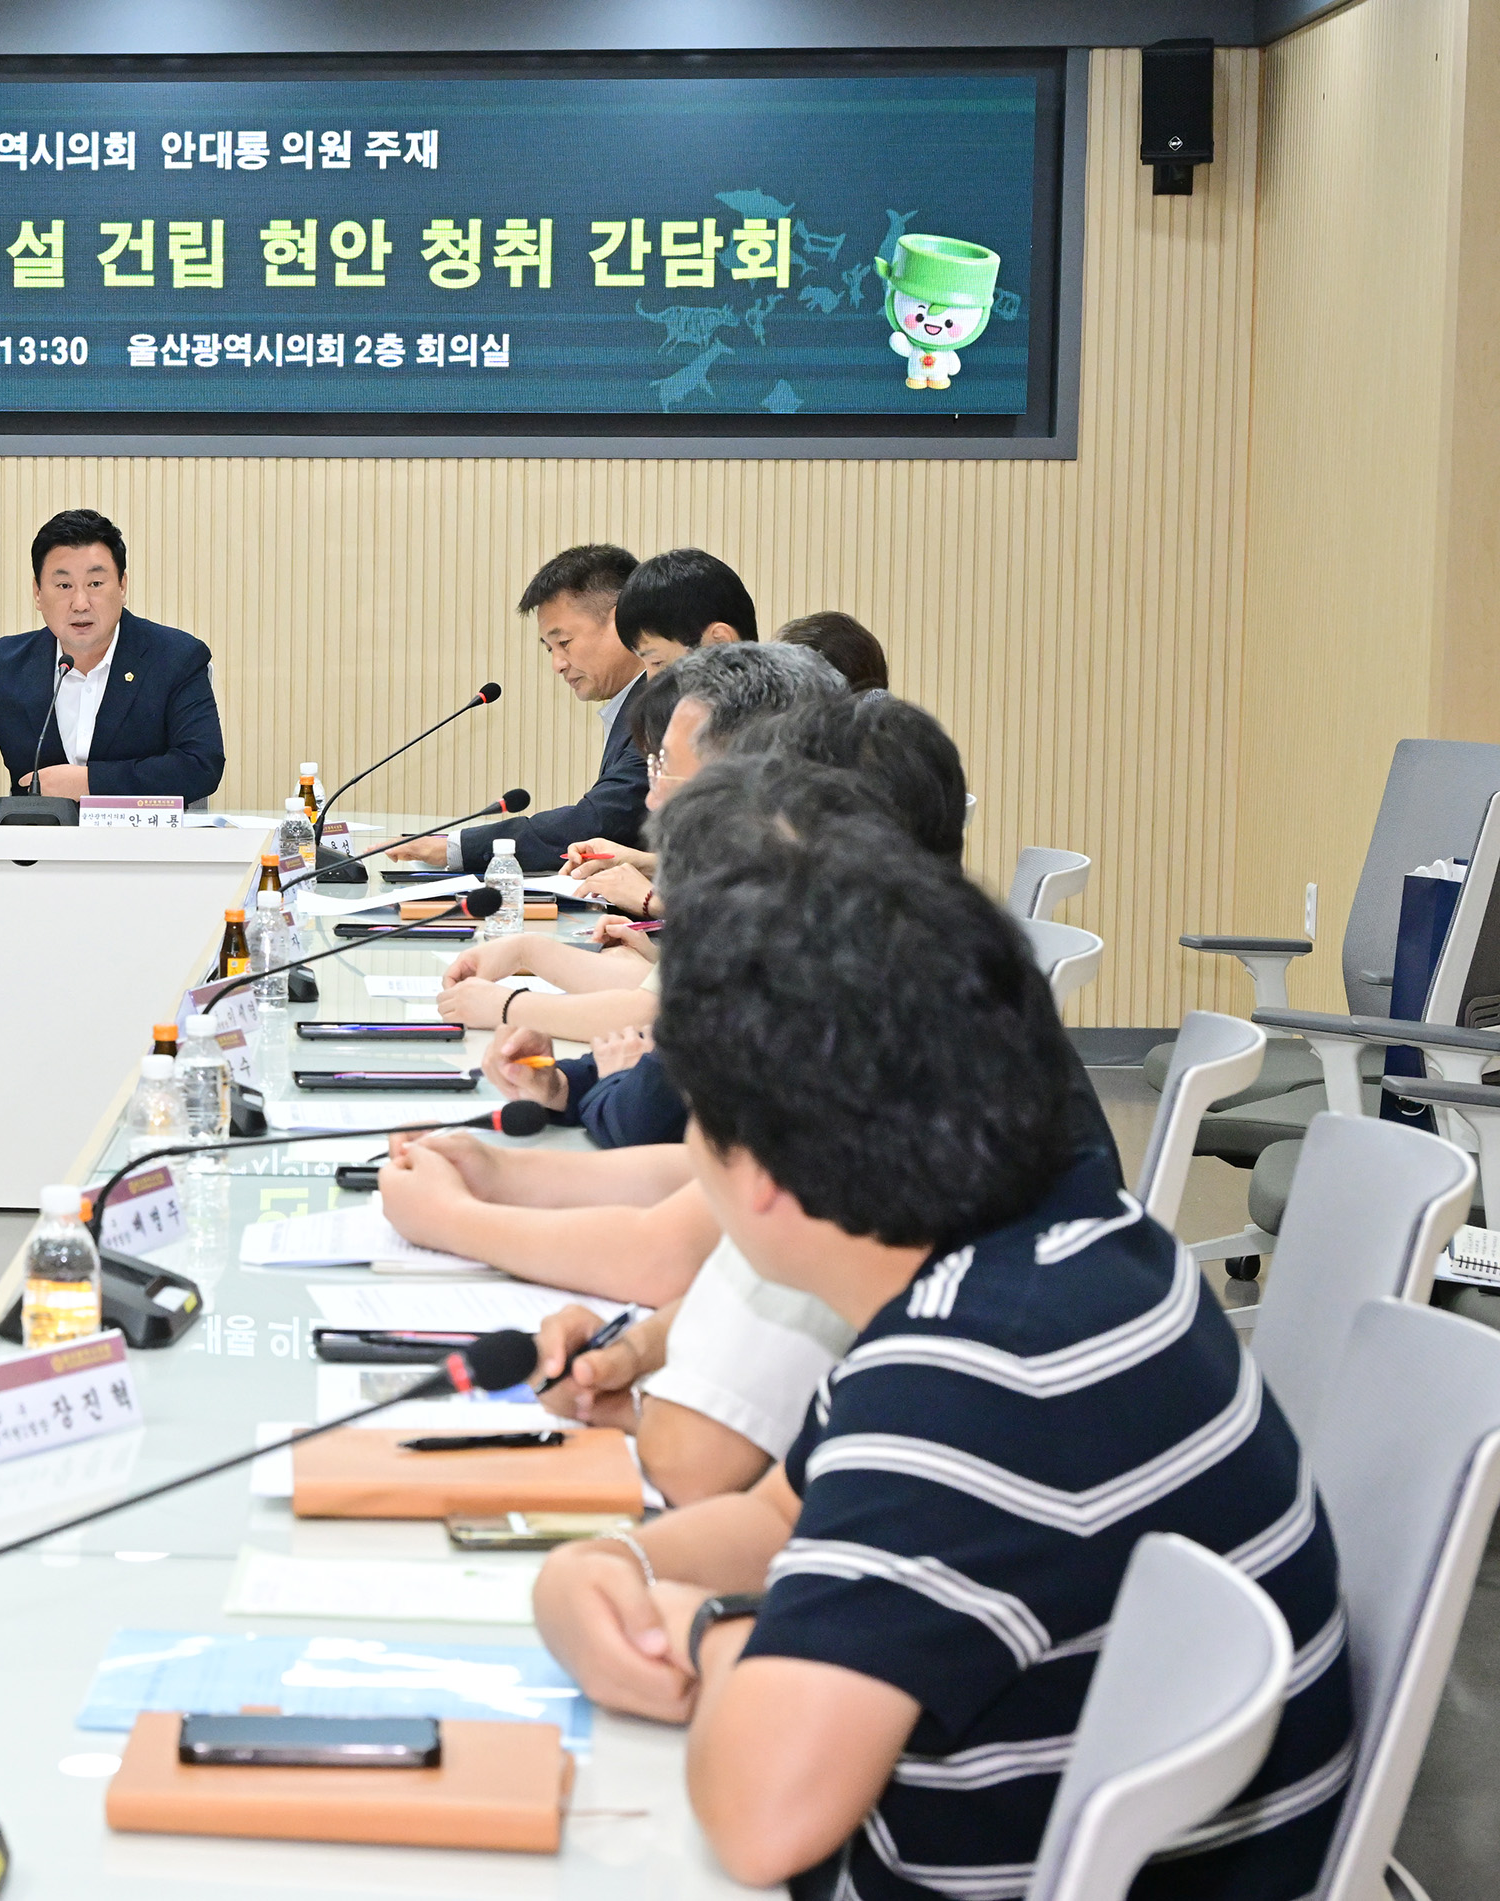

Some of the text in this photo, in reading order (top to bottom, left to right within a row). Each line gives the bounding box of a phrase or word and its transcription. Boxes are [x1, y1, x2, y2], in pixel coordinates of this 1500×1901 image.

[161, 130, 271, 171] 안대룡
[279, 130, 352, 170] 의원
[364, 129, 439, 170] 주재
[97, 219, 225, 289] 건립
[260, 219, 393, 288] 현안
[420, 218, 553, 289] 청취
[588, 218, 791, 289] 간담회
[0, 336, 88, 366] 13:30
[127, 333, 345, 368] 울산광역시의회
[355, 332, 406, 368] 2층
[415, 333, 510, 368] 회의실
